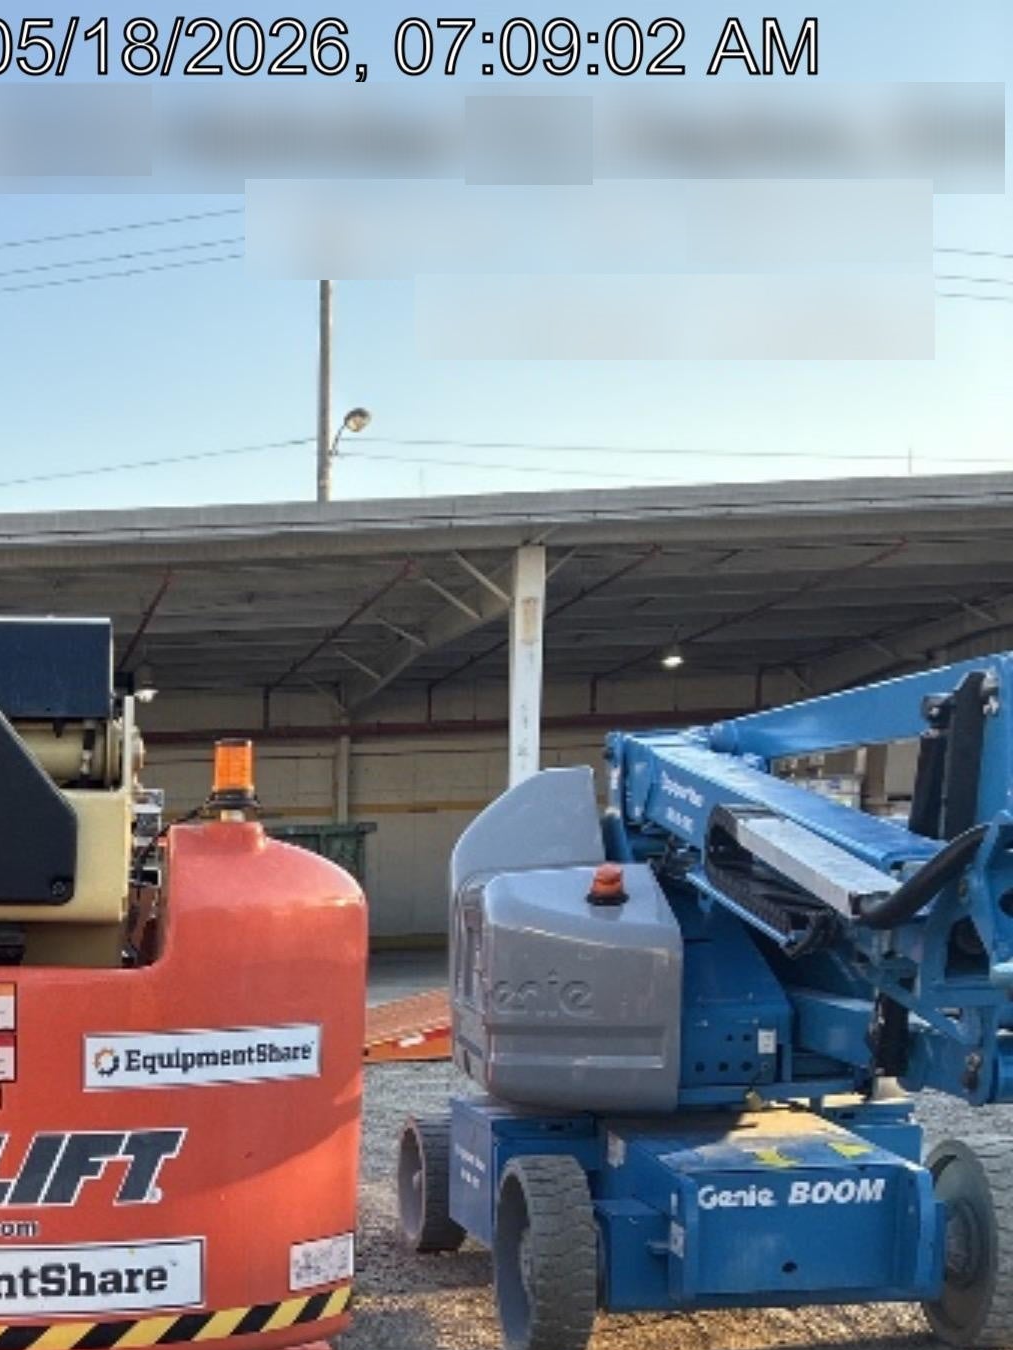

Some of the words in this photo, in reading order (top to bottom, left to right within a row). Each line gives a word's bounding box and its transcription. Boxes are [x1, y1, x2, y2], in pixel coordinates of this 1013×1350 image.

[124, 1042, 312, 1074] EquipmentShare
[697, 1184, 776, 1210] Genie
[787, 1178, 886, 1205] BOOM
